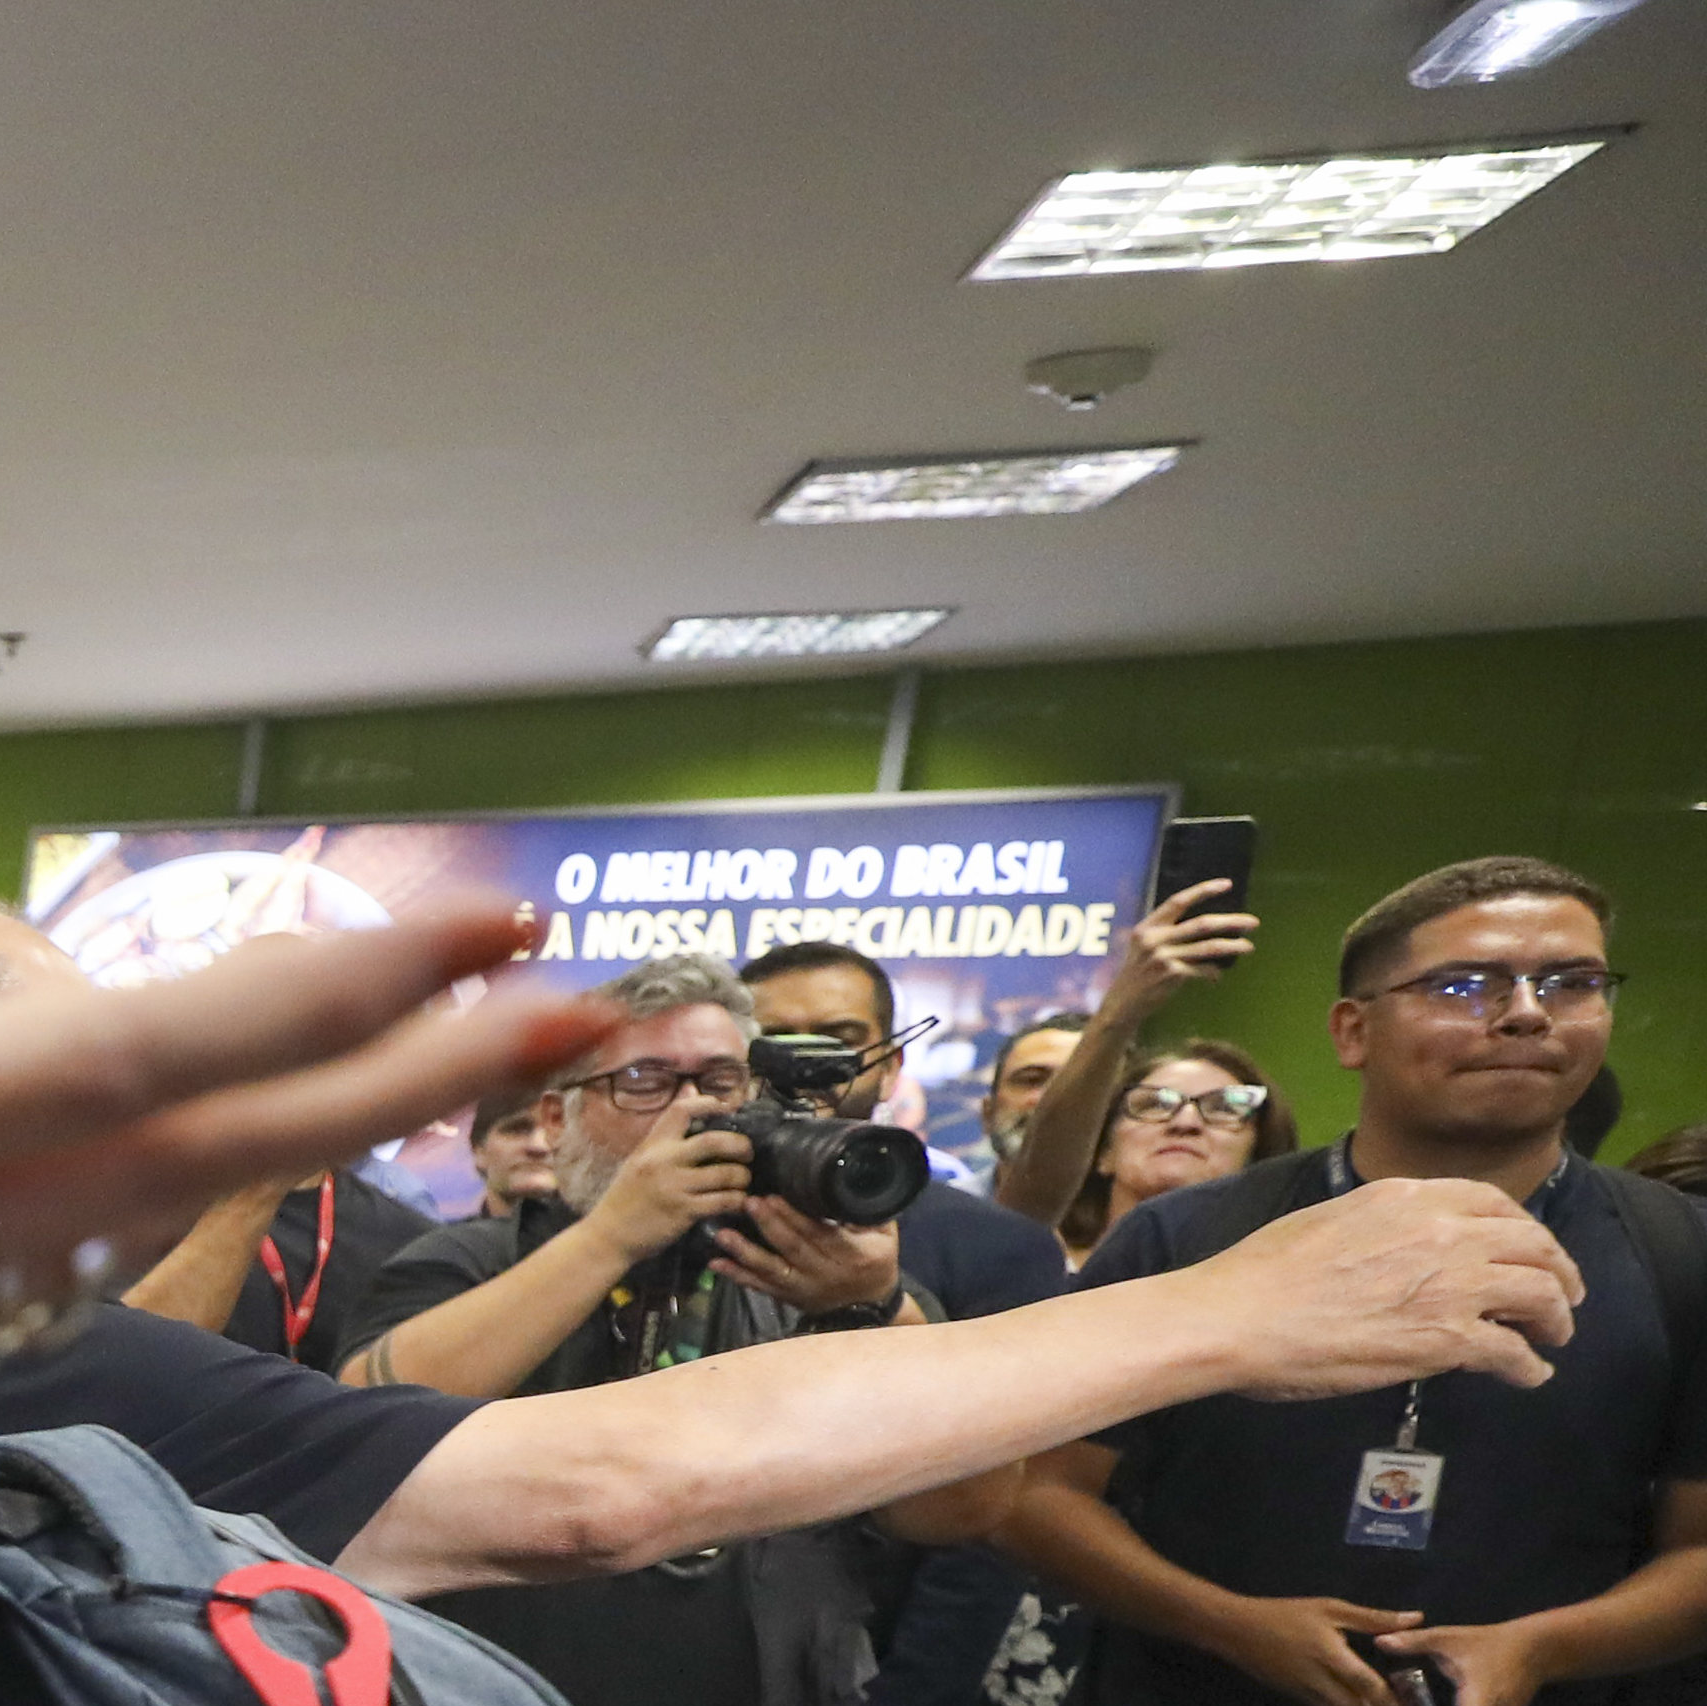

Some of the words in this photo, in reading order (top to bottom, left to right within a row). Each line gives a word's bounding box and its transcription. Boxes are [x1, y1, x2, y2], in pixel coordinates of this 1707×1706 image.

[554, 853, 597, 904] O
[599, 849, 798, 904] MELHOR
[804, 845, 885, 900] DO
[889, 840, 1070, 898] BRASIL
[537, 910, 575, 961] A
[581, 908, 738, 961] NOSSA
[744, 903, 1117, 960] ESPECIALIDADE
